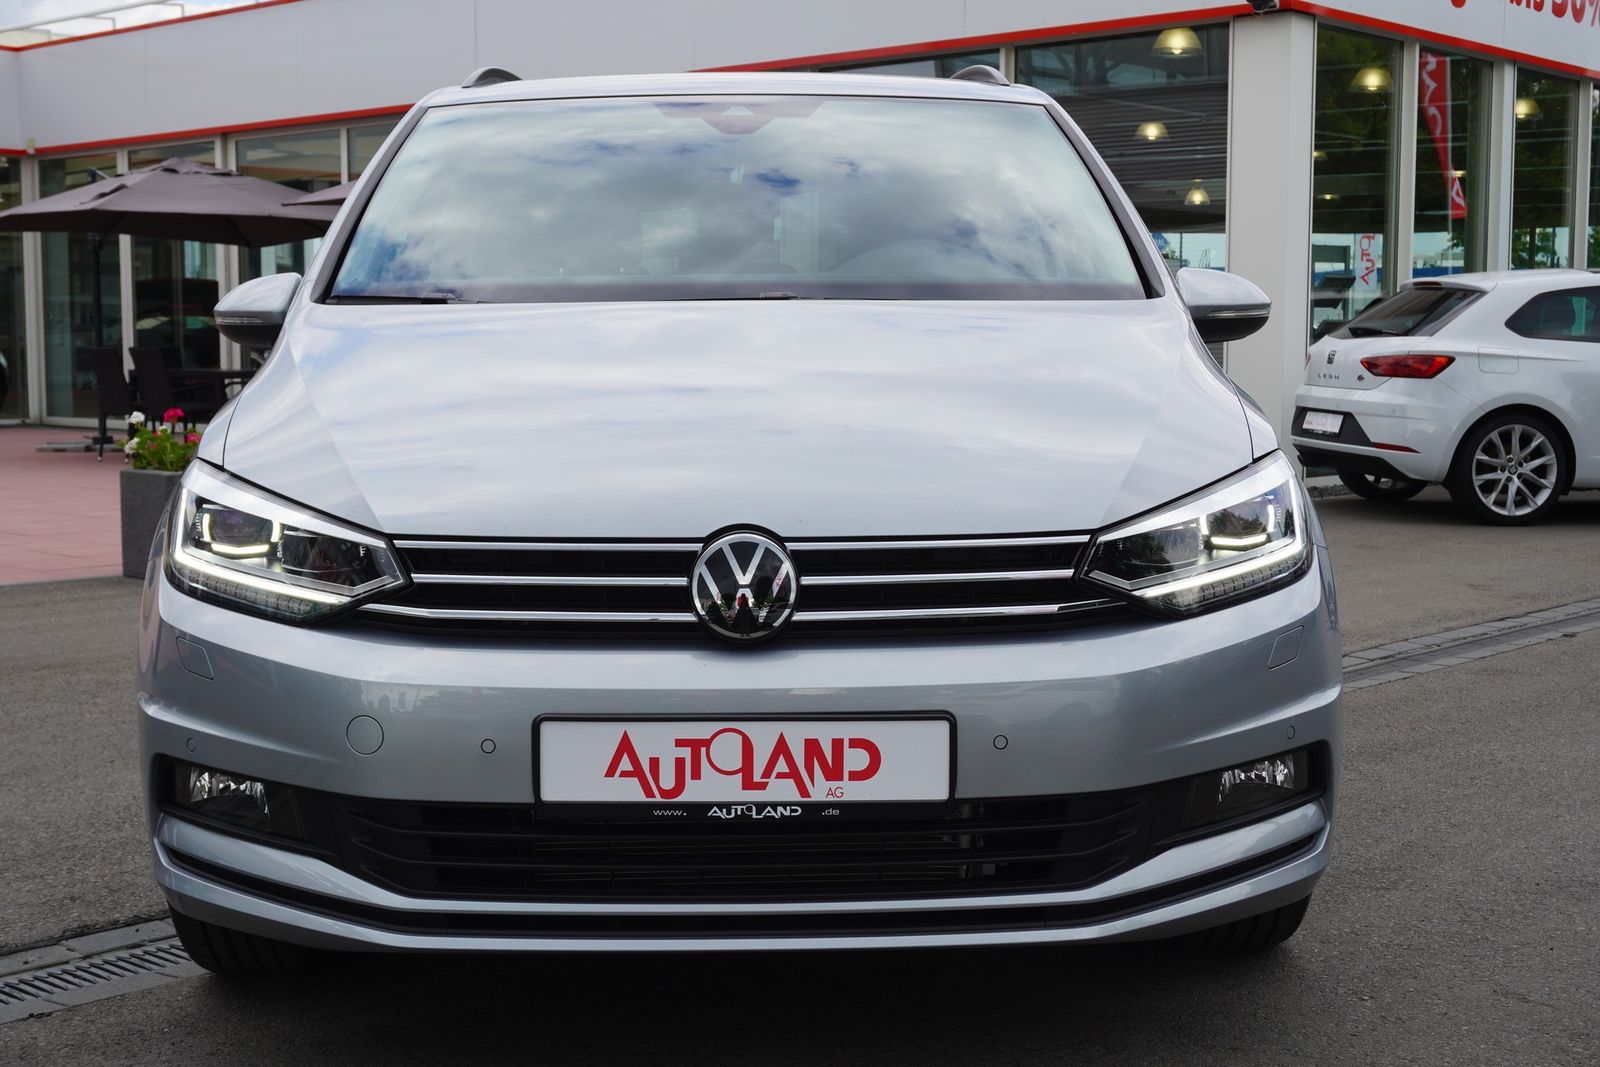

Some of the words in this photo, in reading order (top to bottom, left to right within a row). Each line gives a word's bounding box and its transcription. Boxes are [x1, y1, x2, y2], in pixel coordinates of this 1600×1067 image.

[604, 727, 882, 800] AUTOLAND
[826, 787, 844, 799] AG
[821, 808, 840, 816] .de
